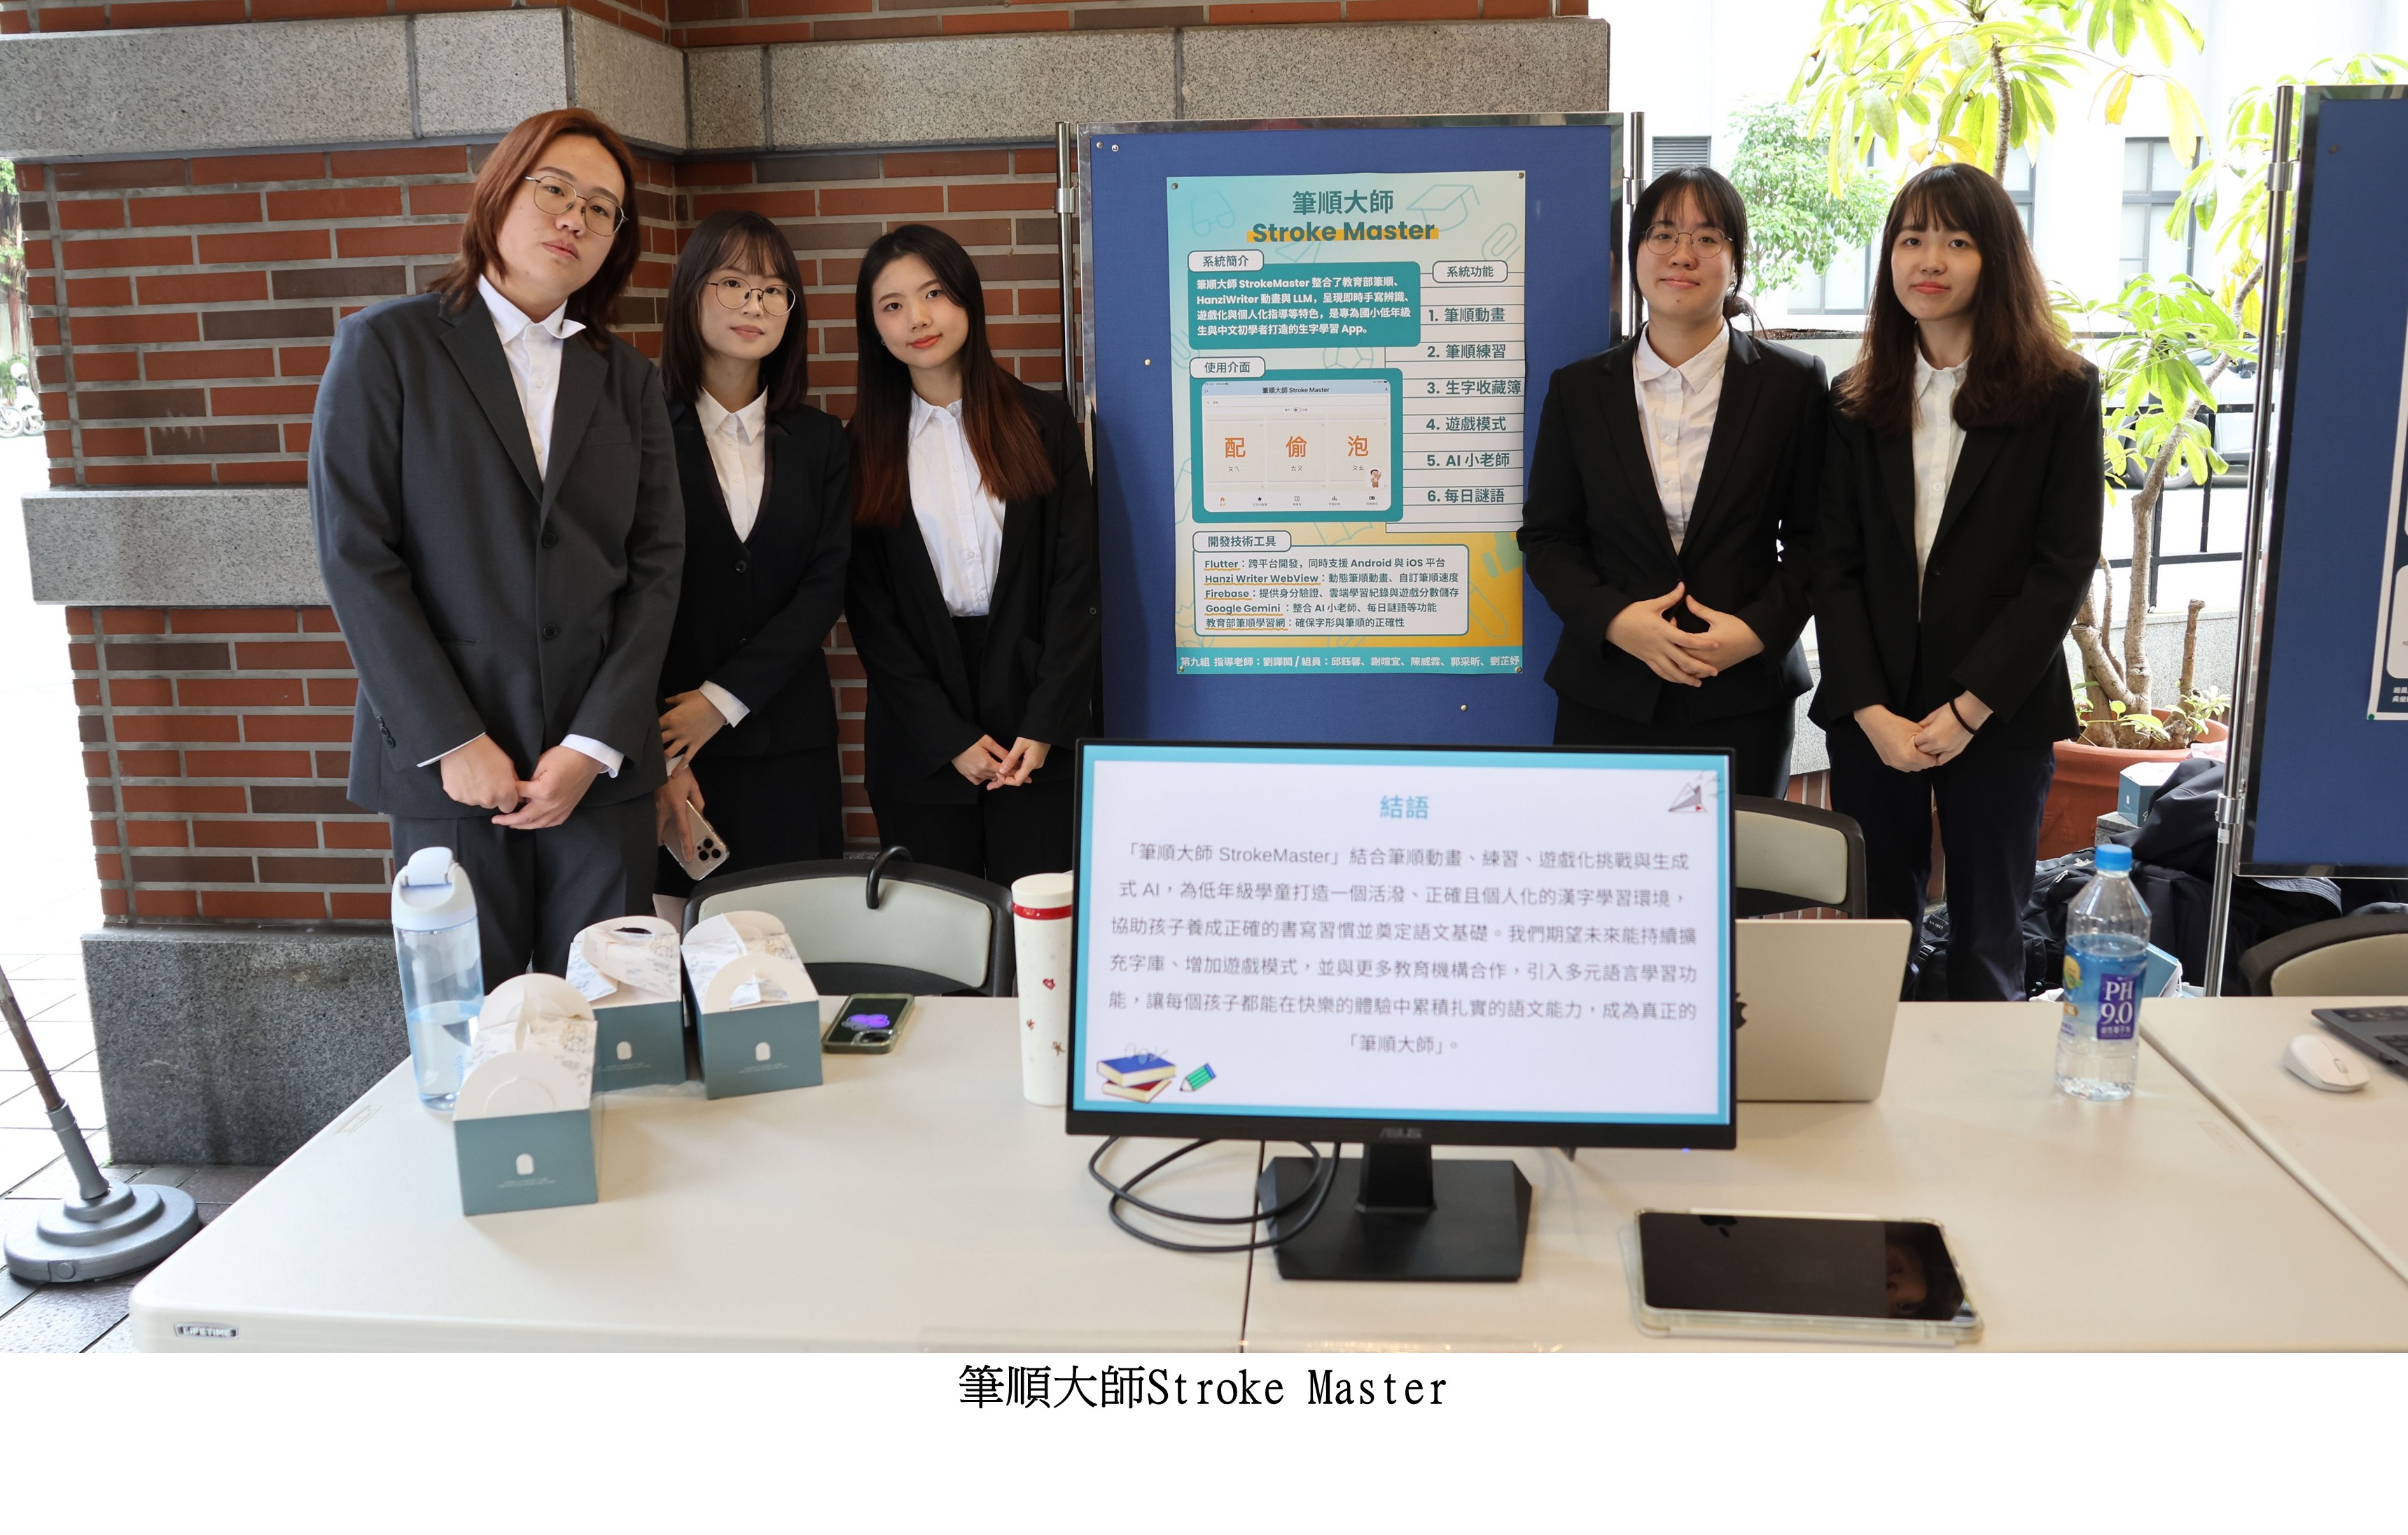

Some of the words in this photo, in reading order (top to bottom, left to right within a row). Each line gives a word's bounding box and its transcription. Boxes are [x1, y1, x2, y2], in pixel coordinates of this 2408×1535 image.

[1293, 190, 1393, 215] 筆順大師
[1253, 223, 1337, 242] Stroke
[1344, 221, 1434, 239] Master
[1203, 256, 1248, 267] 系統簡介
[1447, 266, 1494, 277] 系統功能
[1197, 279, 1237, 289] 筆順大師
[1239, 278, 1309, 288] StrokeMaster
[1312, 276, 1398, 288] 整合了教育部筆順、
[1197, 294, 1258, 304] HanziWriter
[1261, 293, 1290, 304] 動畫與
[1428, 310, 1439, 321] 1.
[1445, 307, 1505, 322] 筆順動畫
[1197, 324, 1338, 336] 生與中文初學者打造的生字學習
[1427, 346, 1440, 358] 2.
[1446, 344, 1506, 359] 筆順練習
[1204, 361, 1250, 373] 使用介面
[1427, 382, 1440, 394] 3.
[1446, 379, 1522, 396] 生字收藏簿
[1426, 419, 1440, 430] 4.
[1446, 416, 1506, 431] 遊戲模式
[1225, 437, 1246, 458] 配
[1286, 436, 1307, 458] 偷
[1347, 435, 1369, 457] 泡
[1427, 454, 1440, 466] 5.
[1446, 454, 1461, 466] AI
[1465, 452, 1509, 468] 小老師
[1427, 490, 1440, 501] 6.
[1445, 488, 1505, 503] 每日謎語
[1208, 535, 1276, 548] 開發技術工具
[1351, 558, 1391, 568] Android
[1394, 558, 1404, 568] 與
[1406, 558, 1423, 568] iOS
[1426, 557, 1445, 568] 平台
[1205, 574, 1233, 583] Hanzi
[1236, 574, 1267, 583] Writer
[1206, 604, 1241, 615] Google
[1244, 603, 1280, 613] Gemini
[1315, 604, 1325, 613] AI
[1181, 656, 1210, 667] 第九組
[1379, 795, 1429, 820] 結語
[1129, 842, 1213, 863] 「筆順大師
[1119, 880, 1137, 899] 式
[2103, 980, 2134, 1001] PH
[2101, 1001, 2133, 1025] 9.0
[183, 1326, 232, 1337] LIFETIME
